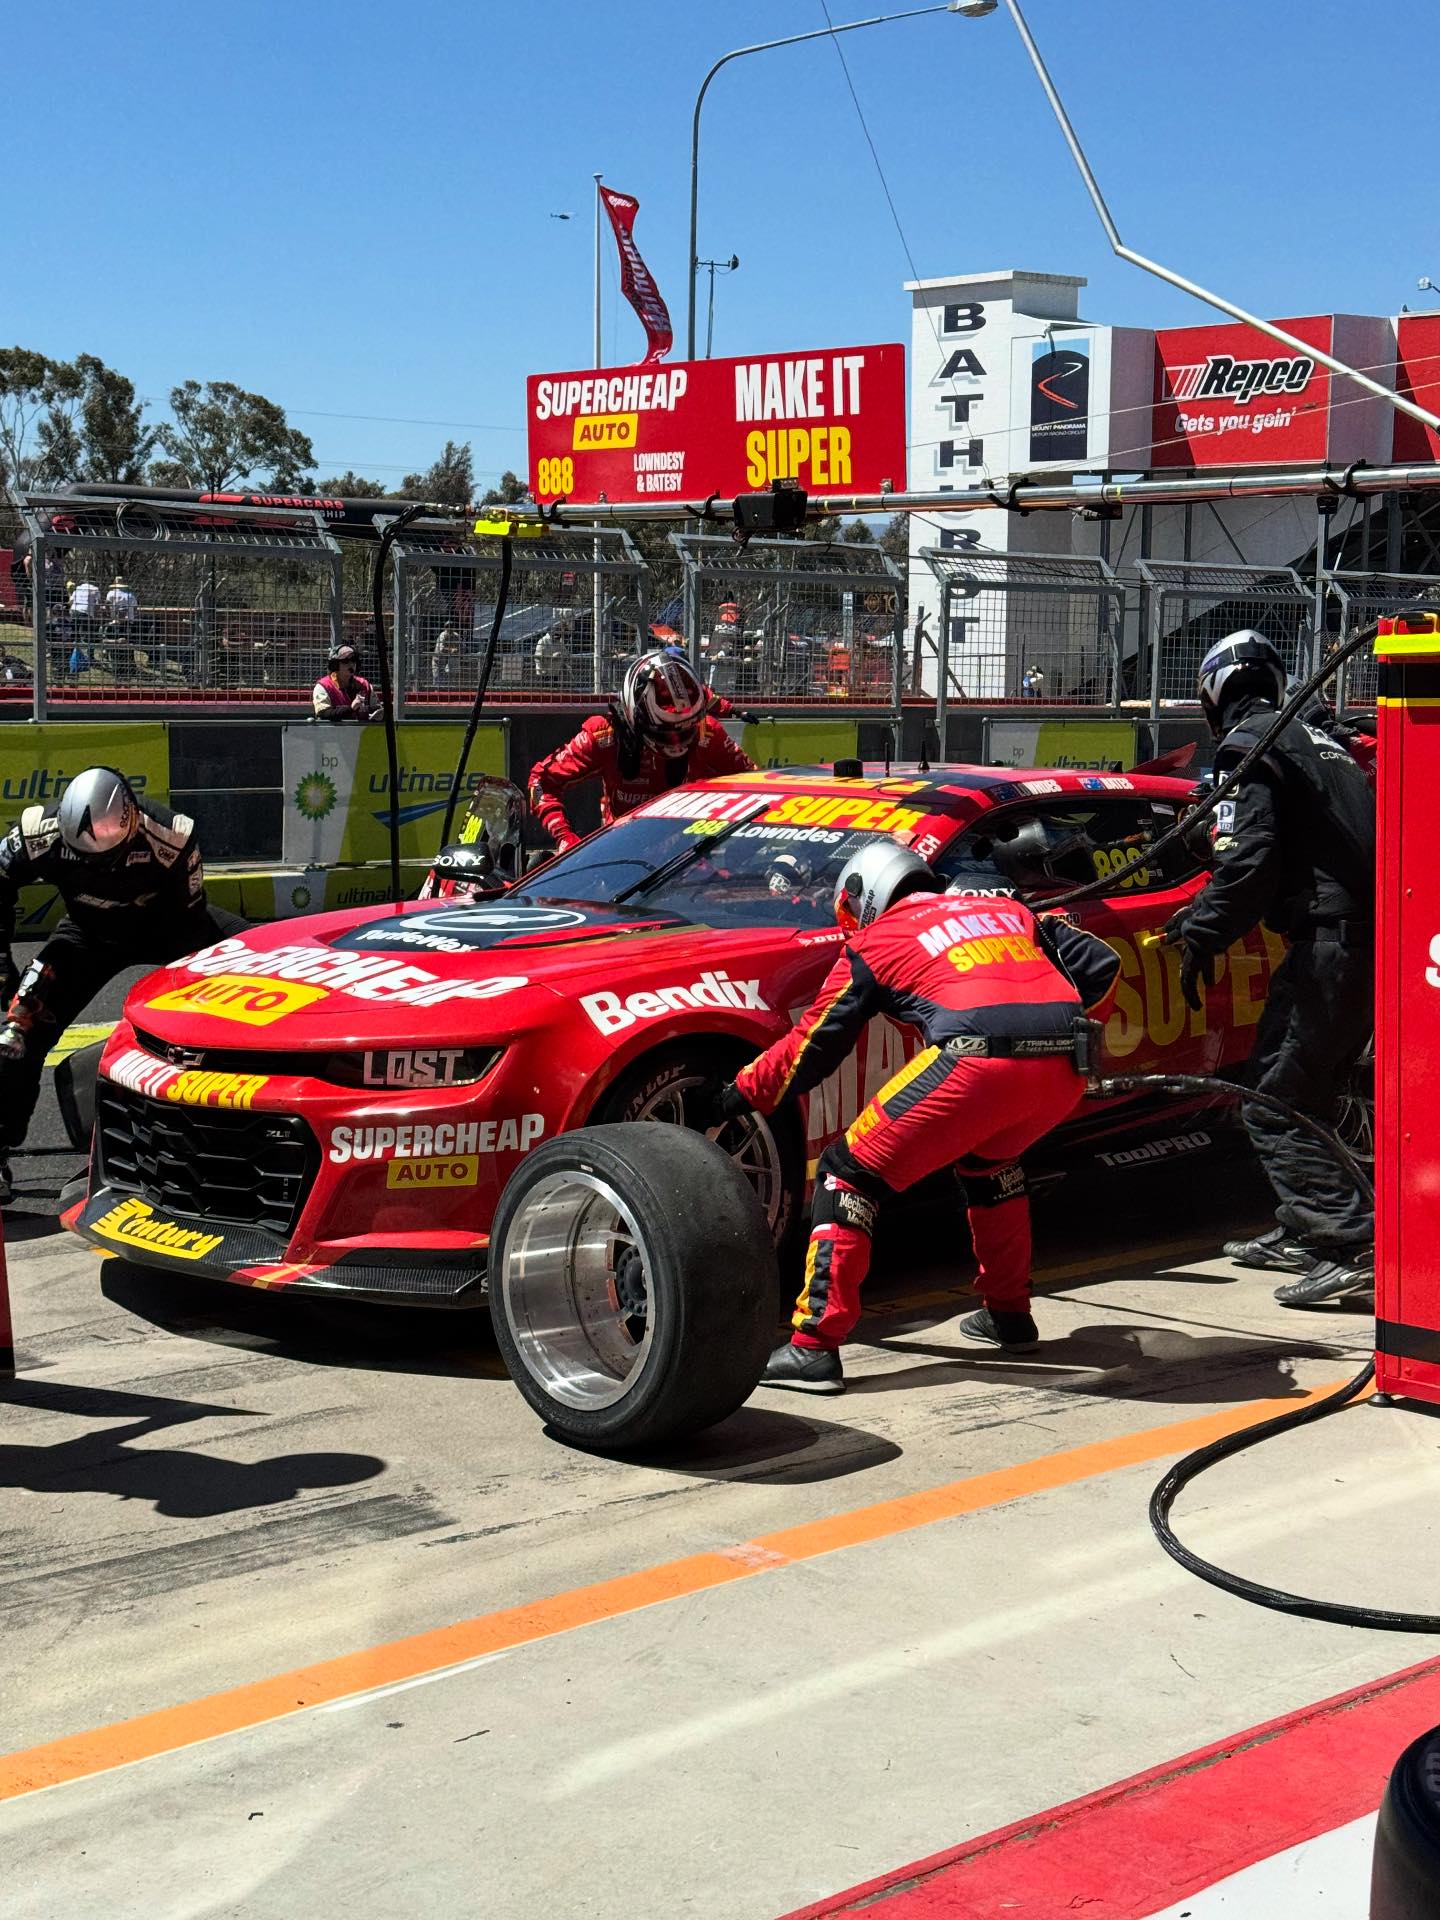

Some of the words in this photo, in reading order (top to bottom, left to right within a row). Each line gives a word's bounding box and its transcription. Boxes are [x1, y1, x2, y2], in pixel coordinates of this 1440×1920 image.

[536, 369, 687, 420] SUPERCHEAP
[735, 358, 824, 422] MAKE
[833, 355, 865, 416] IT
[1200, 355, 1314, 404] Repco
[579, 421, 630, 442] AUTO
[1175, 413, 1213, 433] Gets
[1218, 413, 1249, 435] you
[633, 451, 685, 472] LOWNDESY
[746, 426, 851, 488] SUPER
[938, 302, 987, 643] BATHRST
[538, 457, 574, 495] 888
[637, 478, 644, 493] &
[646, 472, 682, 493] BATESY
[251, 495, 344, 509] SUPERCARS
[321, 754, 338, 769] bp
[369, 766, 486, 793] utimate
[4, 769, 146, 799] ultie
[633, 792, 736, 819] MAKE
[762, 796, 927, 832] SUPER
[683, 820, 729, 836] 888
[731, 823, 843, 844] Lowndes
[432, 853, 485, 867] SONY
[337, 885, 404, 904] ultimat
[917, 914, 1005, 958] MAKE
[995, 912, 1025, 934] IT
[947, 935, 1044, 972] SUPER
[165, 939, 528, 1008] SUPERCHEAP
[170, 982, 289, 1012] AUTO
[578, 970, 770, 1036] Bendix
[363, 1050, 465, 1086] LOST
[166, 1070, 270, 1110] SUPER
[329, 1113, 545, 1164] SUPERCHEAP
[397, 1162, 469, 1181] AUTO
[112, 1200, 225, 1259] Century
